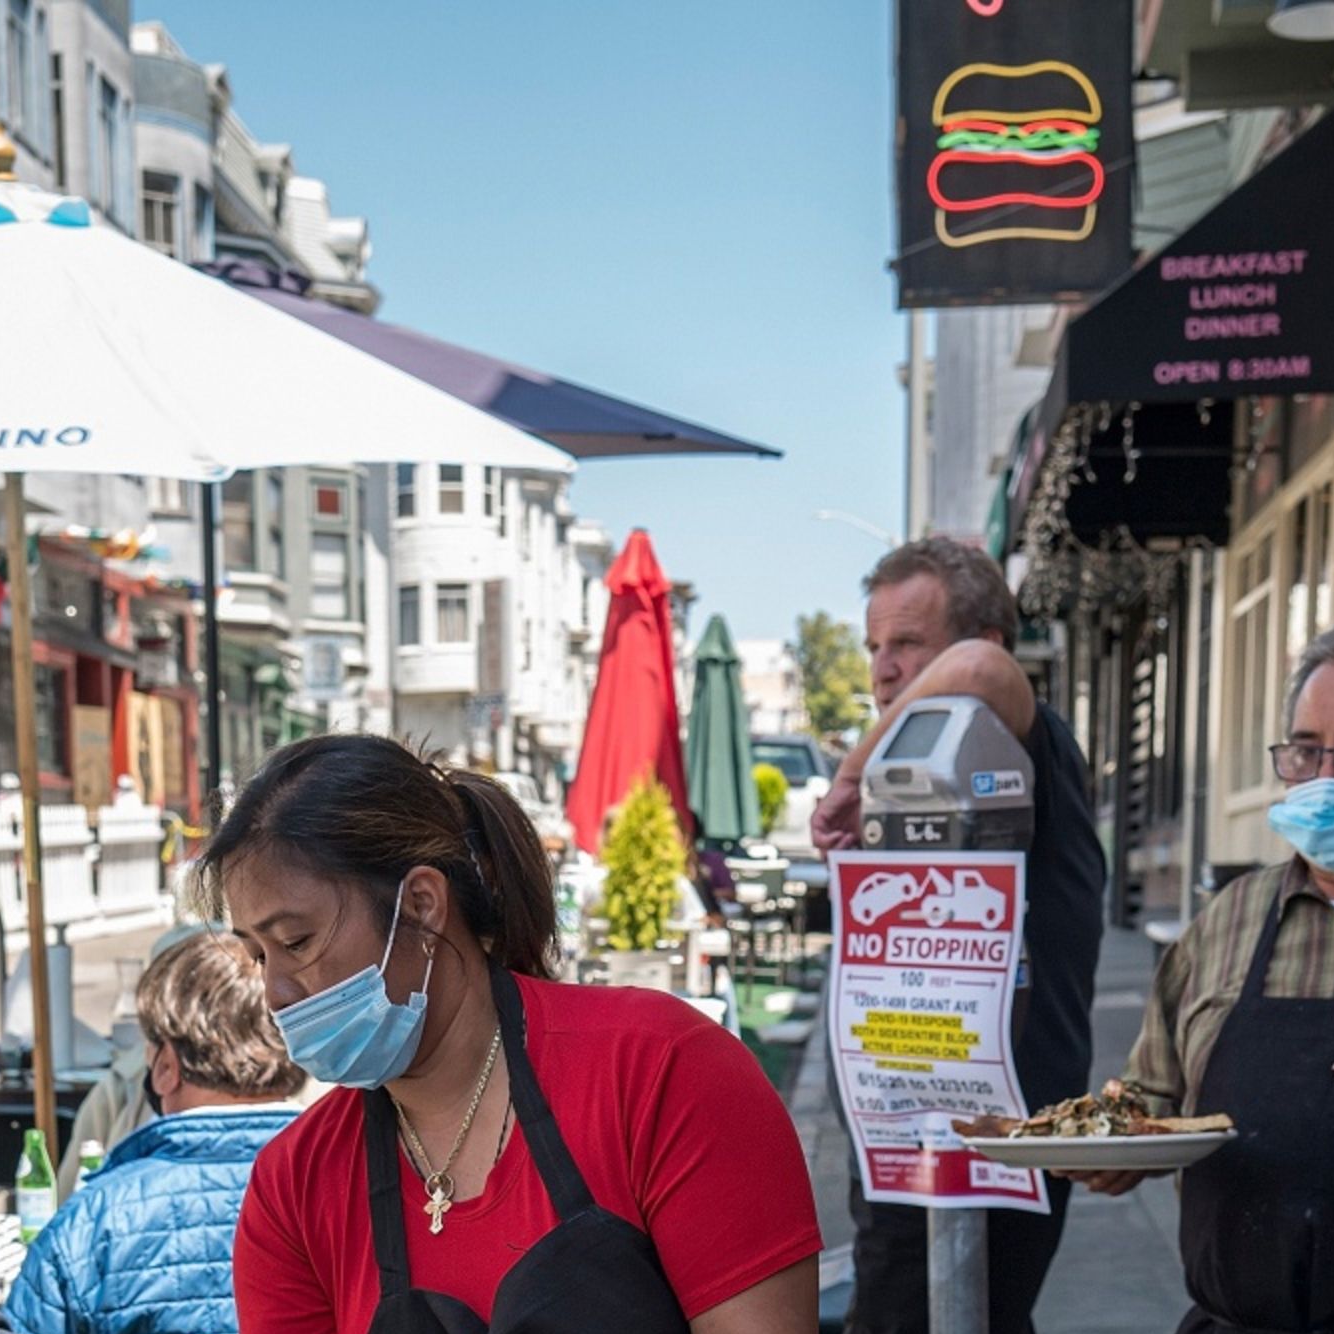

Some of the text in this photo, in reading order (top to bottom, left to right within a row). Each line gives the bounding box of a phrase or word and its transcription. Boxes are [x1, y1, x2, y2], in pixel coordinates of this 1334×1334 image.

[1160, 250, 1307, 280] BREAKFAST
[1189, 282, 1277, 309] LUNCH
[1184, 312, 1281, 340] DINNER
[1153, 356, 1311, 384] OPEN 8:30AM
[847, 933, 1005, 962] NO STOPPING
[900, 972, 925, 987] 100
[910, 996, 950, 1012] GRANT
[953, 999, 979, 1014] AVE
[866, 1012, 962, 1028] COVID-19 RESPONSE
[945, 1032, 980, 1045] BLOCK
[897, 1043, 940, 1057] LOADING
[908, 1077, 927, 1091] to
[929, 1079, 994, 1095] 12/31/20
[890, 1098, 915, 1111] am
